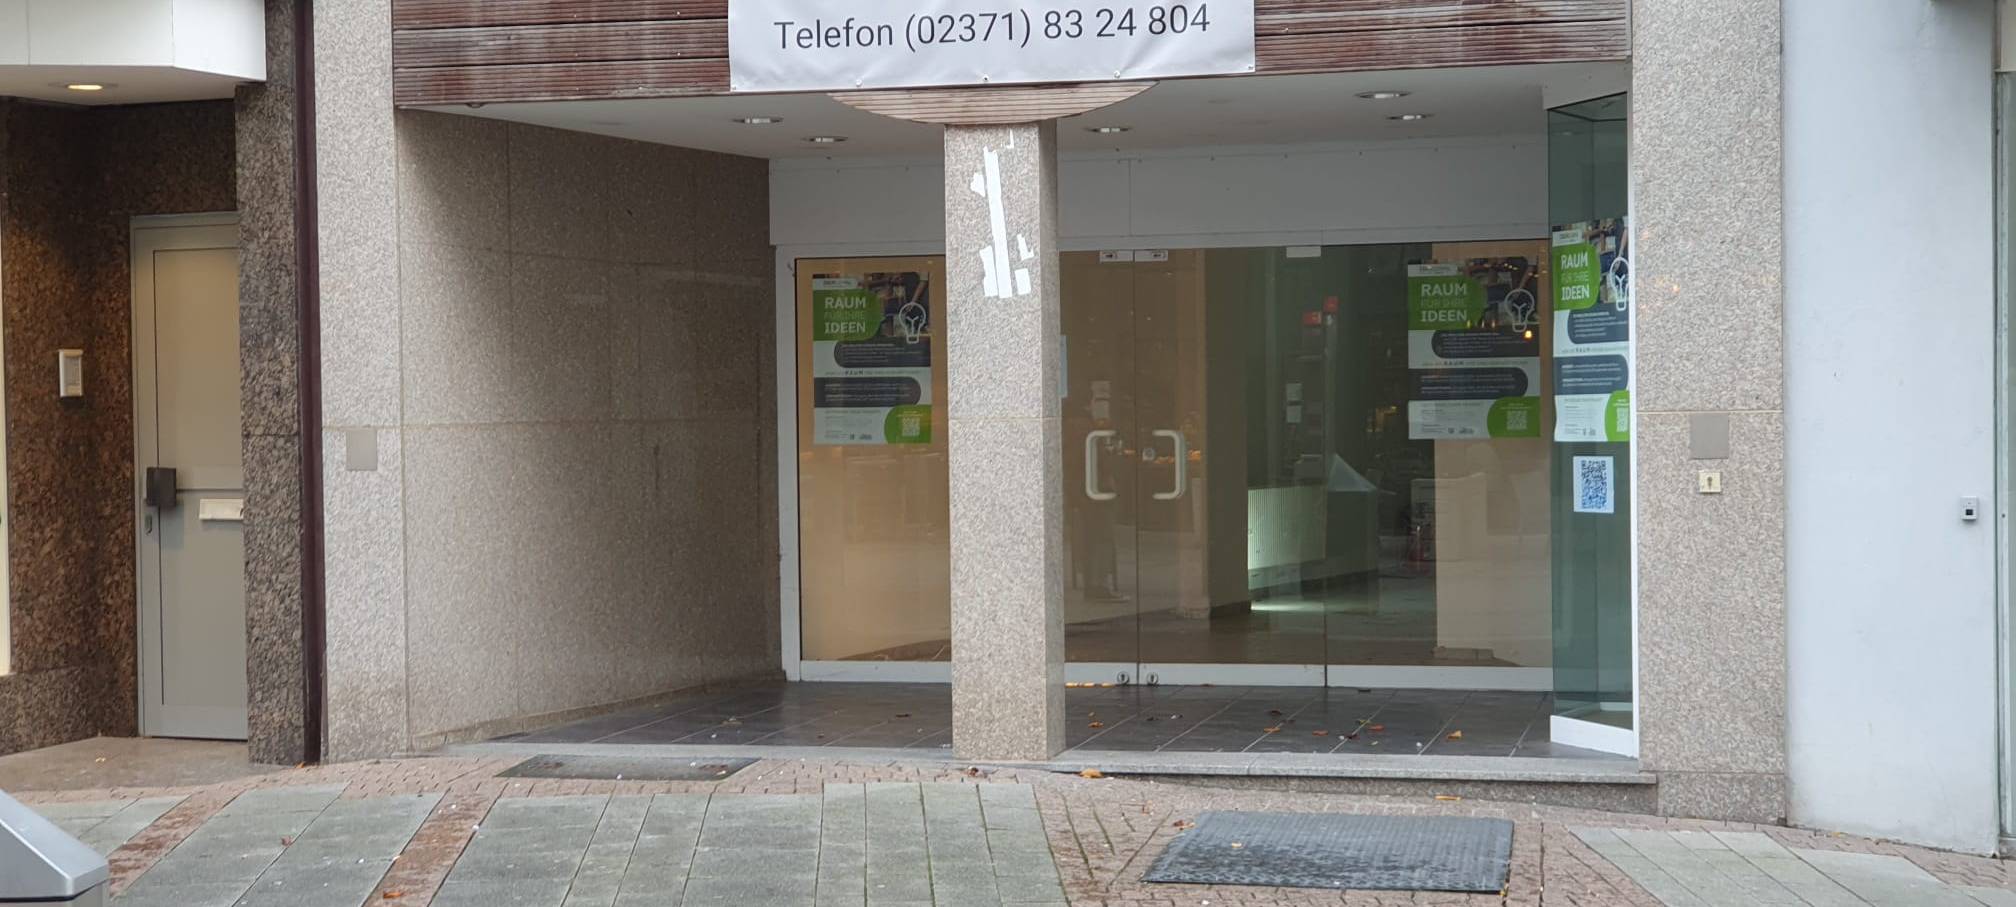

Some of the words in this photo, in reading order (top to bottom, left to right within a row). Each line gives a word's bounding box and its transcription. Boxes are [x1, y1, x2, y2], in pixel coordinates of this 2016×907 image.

[773, 17, 894, 49] Telefon
[905, 8, 1031, 53] (02371)
[1043, 9, 1084, 39] 83
[1095, 7, 1137, 38] 24
[1148, 3, 1211, 35] 804
[1561, 251, 1589, 270] RAUM
[1421, 282, 1467, 297] RAUM
[1561, 283, 1590, 301] IDEEN
[824, 296, 867, 310] RAUM
[1420, 309, 1468, 323] IDEEN
[824, 320, 866, 334] IDEEN
